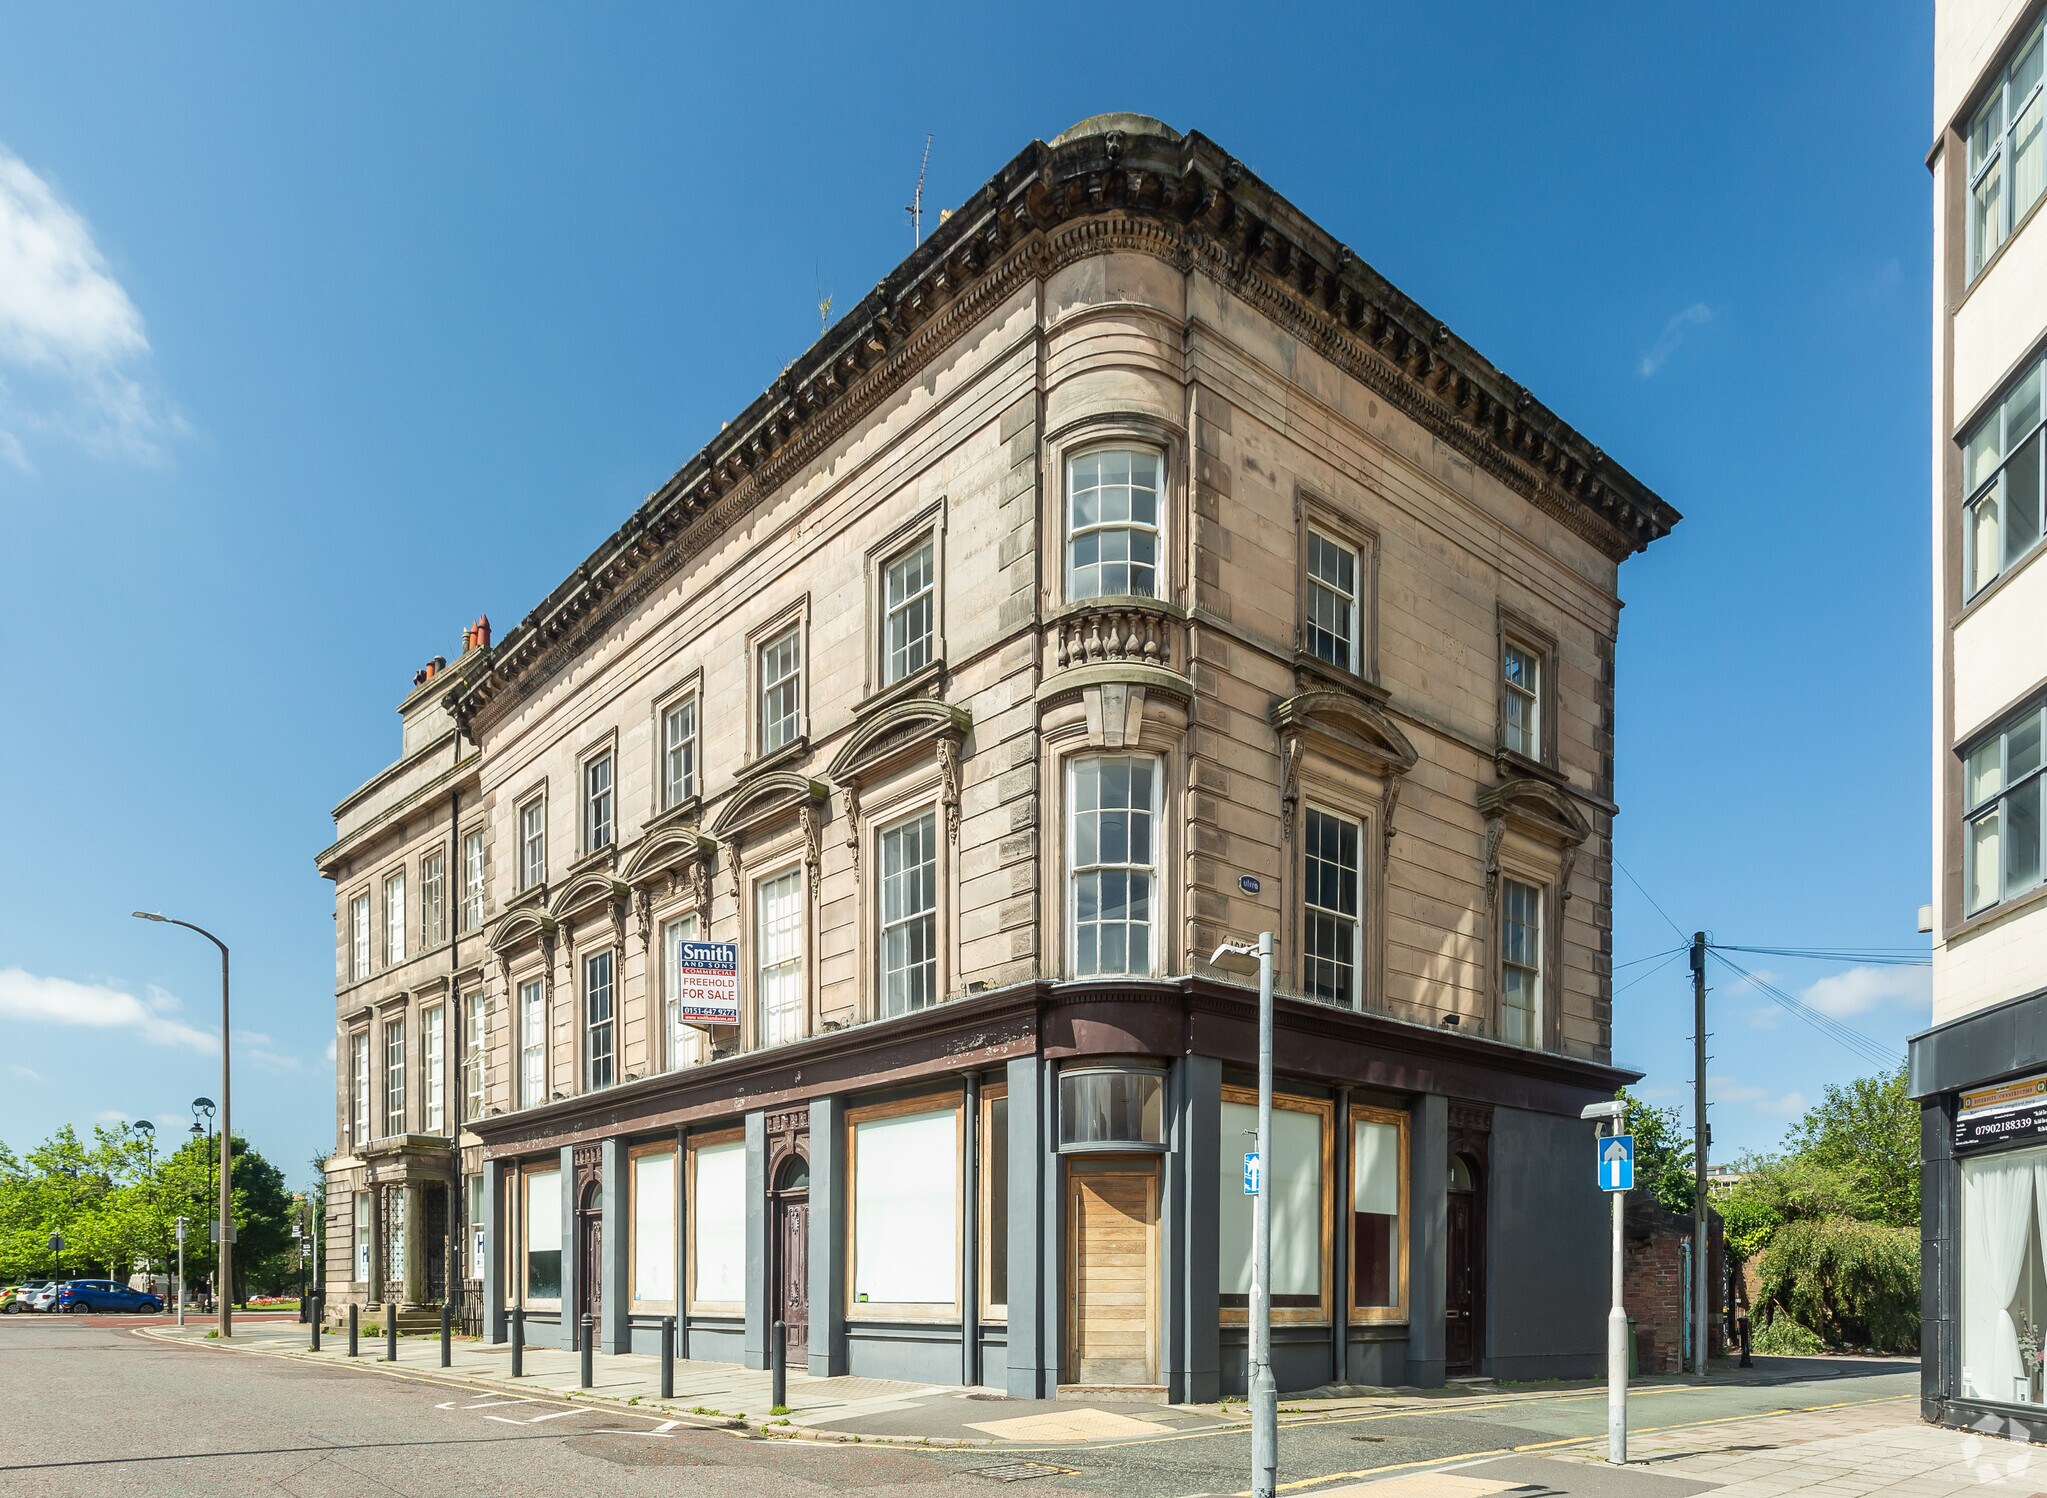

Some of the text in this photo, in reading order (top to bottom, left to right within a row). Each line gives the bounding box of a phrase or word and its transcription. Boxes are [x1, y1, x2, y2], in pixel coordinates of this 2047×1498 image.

[684, 944, 733, 962] Smith
[685, 968, 733, 976] COMMERCIAL
[684, 978, 735, 988] FREEHOLD
[683, 989, 735, 1000] FOR SALE
[1975, 1117, 2032, 1136] 07902188339
